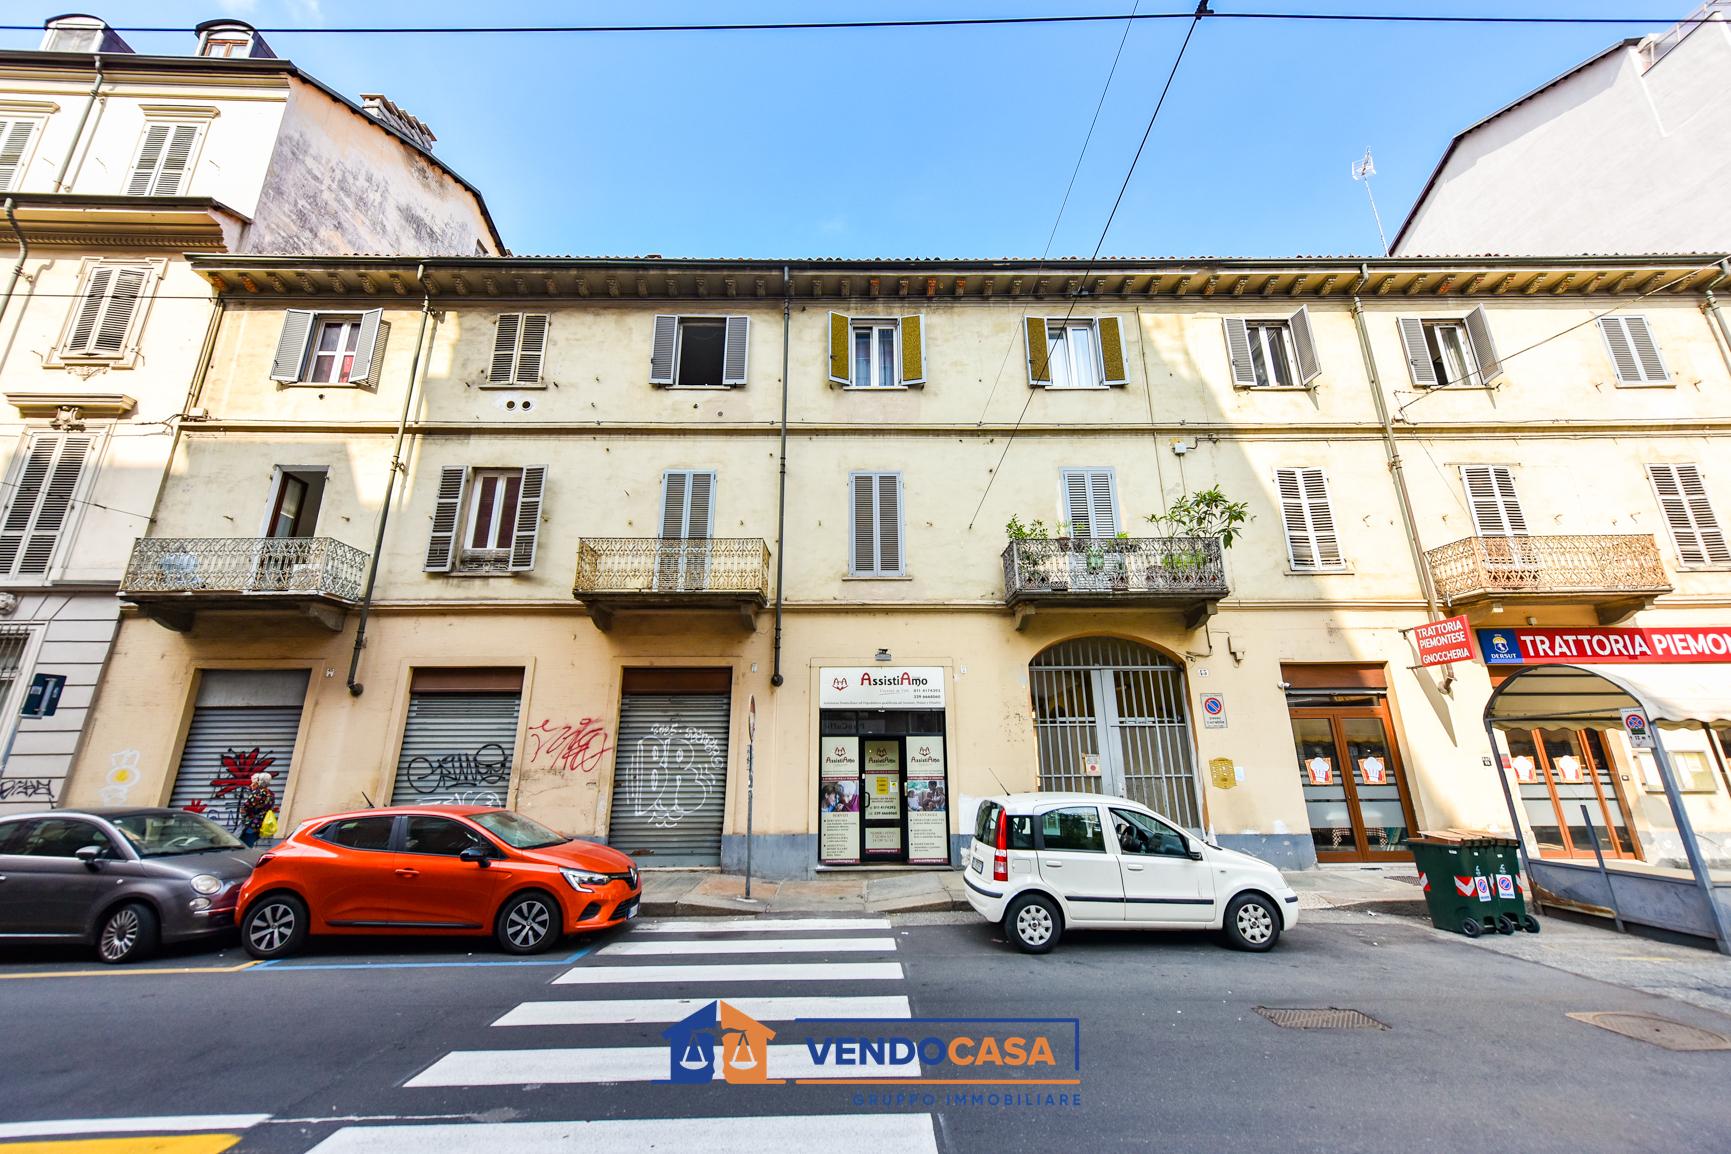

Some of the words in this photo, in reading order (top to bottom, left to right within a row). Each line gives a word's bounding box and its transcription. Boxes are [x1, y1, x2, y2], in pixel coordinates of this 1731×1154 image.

[1416, 620, 1463, 639] TRATTORIA
[1419, 631, 1466, 649] PIEMONTESE
[1520, 634, 1652, 657] TRATTORIA
[1422, 647, 1470, 664] GNOCCHERIA
[860, 671, 928, 687] AssistiAmo
